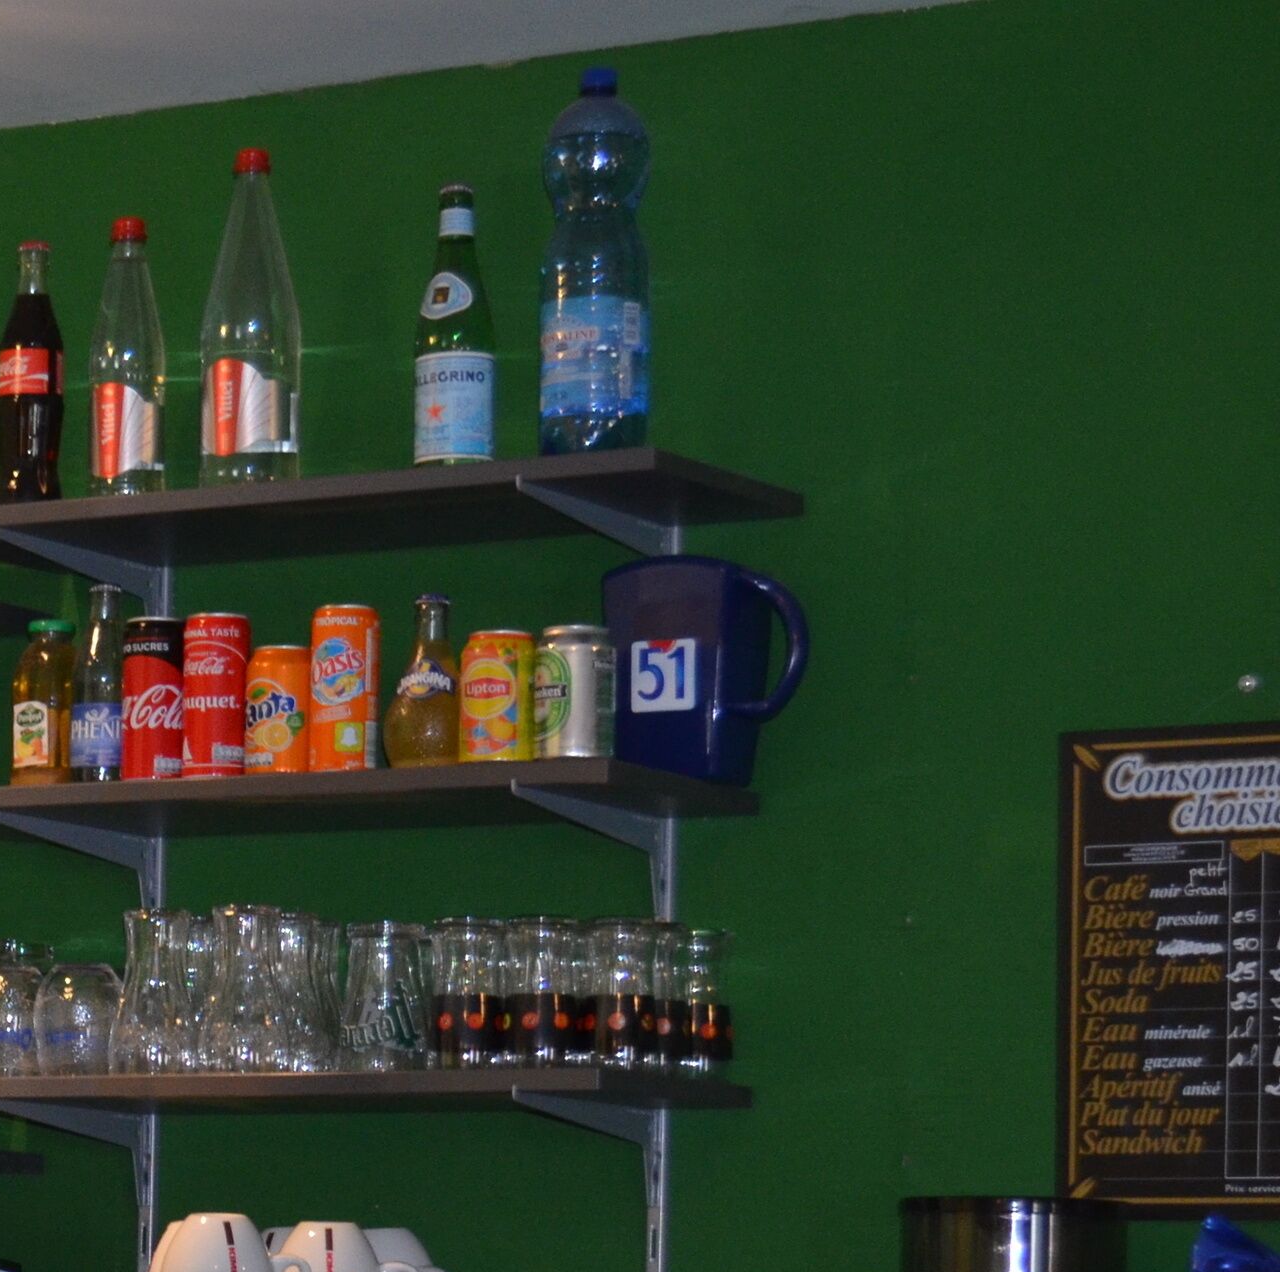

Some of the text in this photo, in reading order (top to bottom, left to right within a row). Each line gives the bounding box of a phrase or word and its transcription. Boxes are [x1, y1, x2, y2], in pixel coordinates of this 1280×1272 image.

[132, 642, 169, 652] SUCRES
[637, 650, 685, 702] 51
[466, 683, 506, 697] Lipton
[246, 692, 296, 729] anta
[71, 719, 121, 740] PHENI
[1084, 874, 1181, 902] Café noir
[1183, 881, 1227, 897] Grand
[1084, 904, 1220, 931] Bière pression
[1083, 931, 1154, 958] Bière
[1081, 957, 1223, 990] Jus de fruits
[1081, 988, 1149, 1014] Soda
[1082, 1016, 1211, 1042] Eau minérale
[1081, 1044, 1203, 1072] Eau gazeuse
[1080, 1072, 1222, 1105] Apéritif anisé
[1081, 1101, 1221, 1130] Plat du jour
[1079, 1129, 1207, 1155] Sandwich
